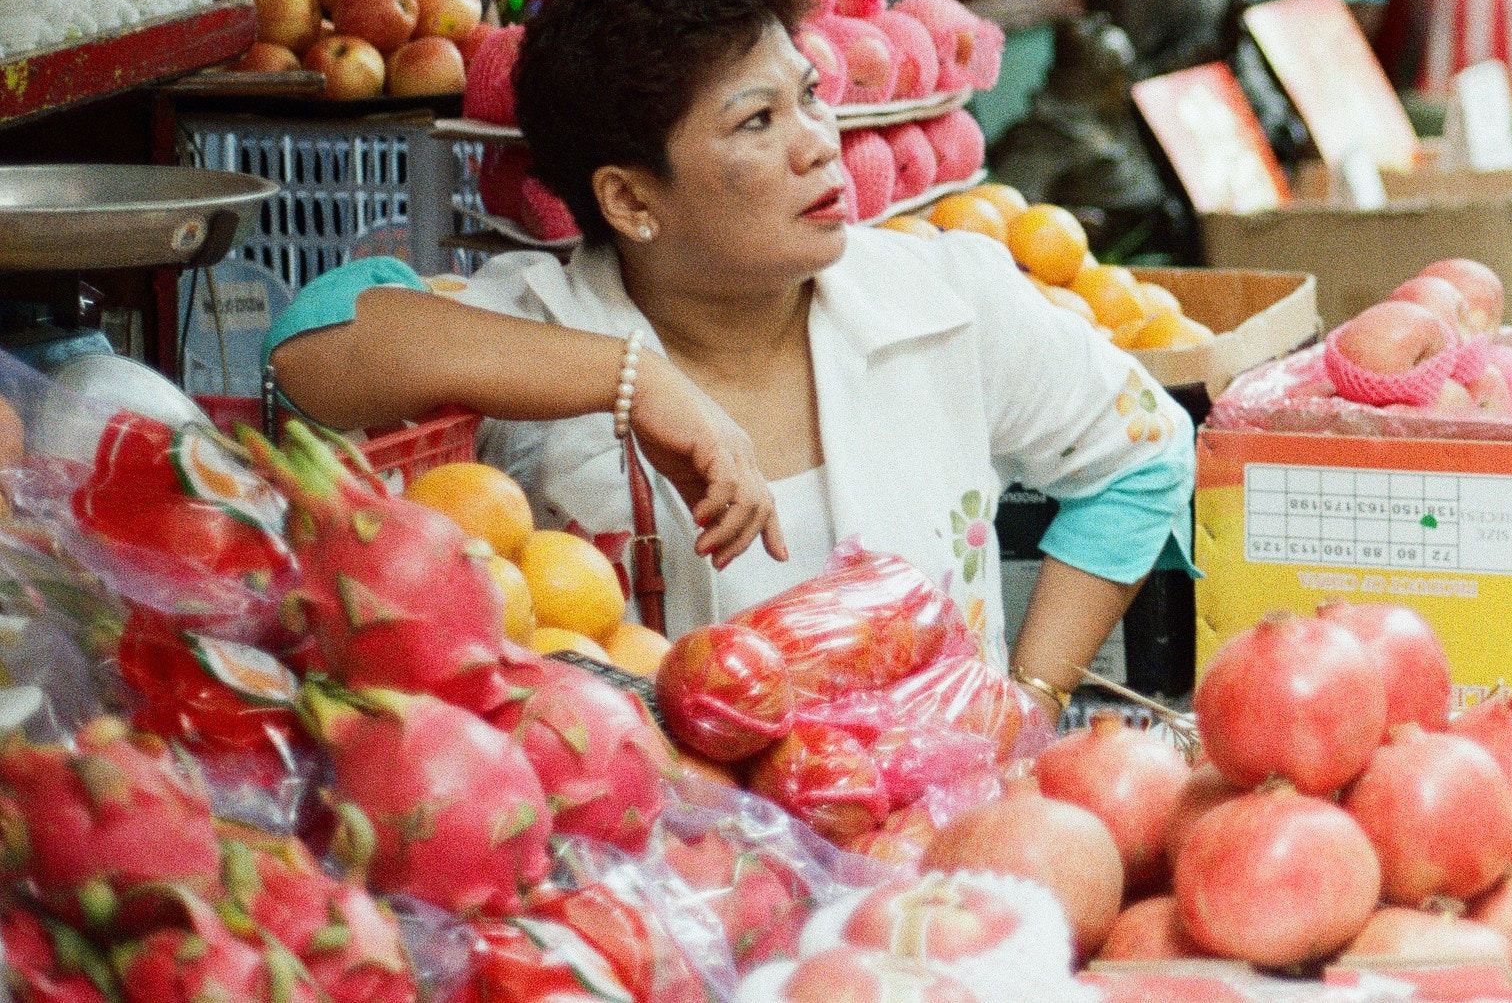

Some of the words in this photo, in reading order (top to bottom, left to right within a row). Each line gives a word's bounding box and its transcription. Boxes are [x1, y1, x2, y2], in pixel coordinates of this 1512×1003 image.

[1289, 499, 1319, 511] 198
[1324, 500, 1352, 512] 175
[1357, 502, 1386, 514] 163
[1392, 504, 1421, 515] 150
[1252, 541, 1281, 552] 125
[1289, 543, 1318, 554] 113
[1324, 545, 1352, 556] 100
[1364, 547, 1382, 558] 88
[1397, 548, 1417, 560] 80
[1432, 550, 1450, 561] 72
